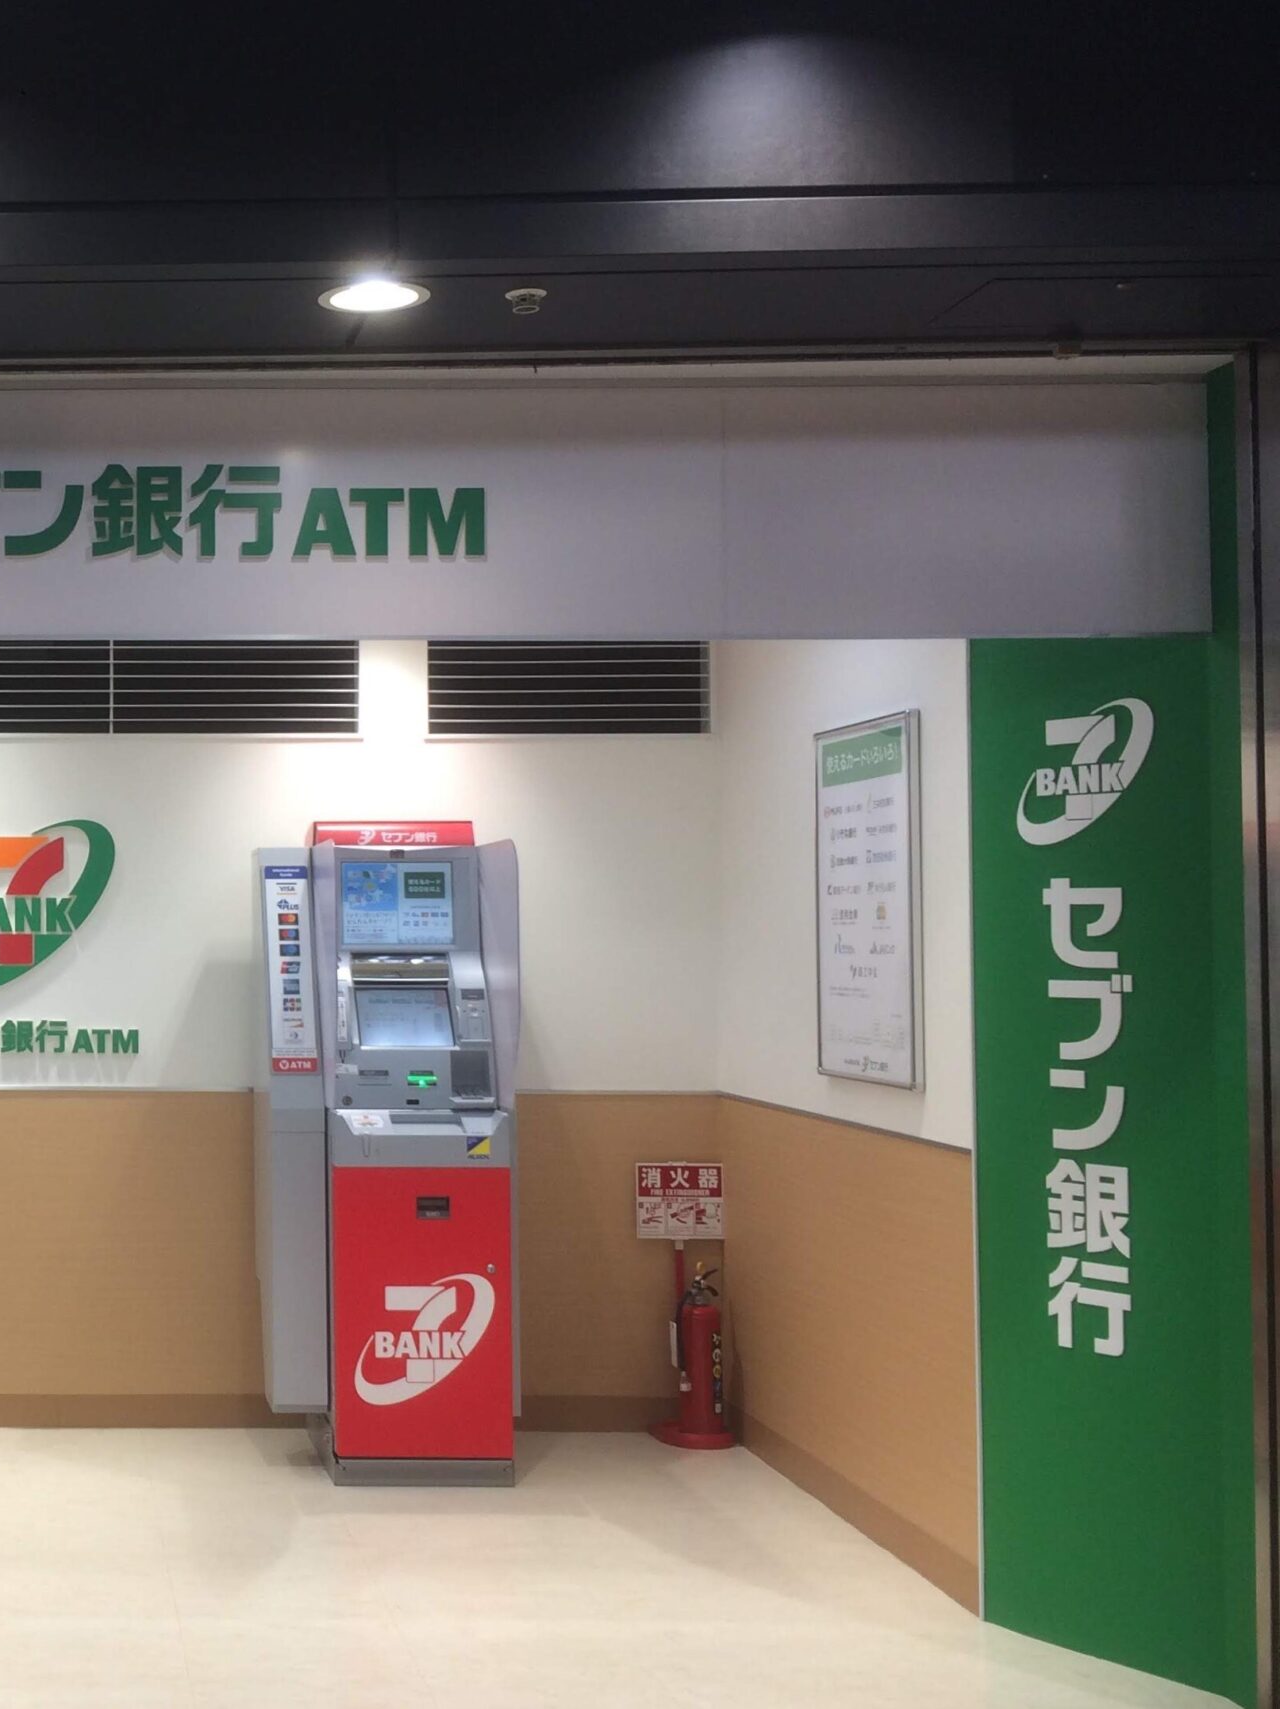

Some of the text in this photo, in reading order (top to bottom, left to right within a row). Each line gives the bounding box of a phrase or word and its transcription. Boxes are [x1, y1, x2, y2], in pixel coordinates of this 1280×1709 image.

[1036, 763, 1122, 797] BANK
[290, 1061, 312, 1069] ATM
[1042, 878, 1133, 1357] セブン銀行
[641, 1167, 719, 1188] 消火器
[374, 1331, 467, 1358] BANK
